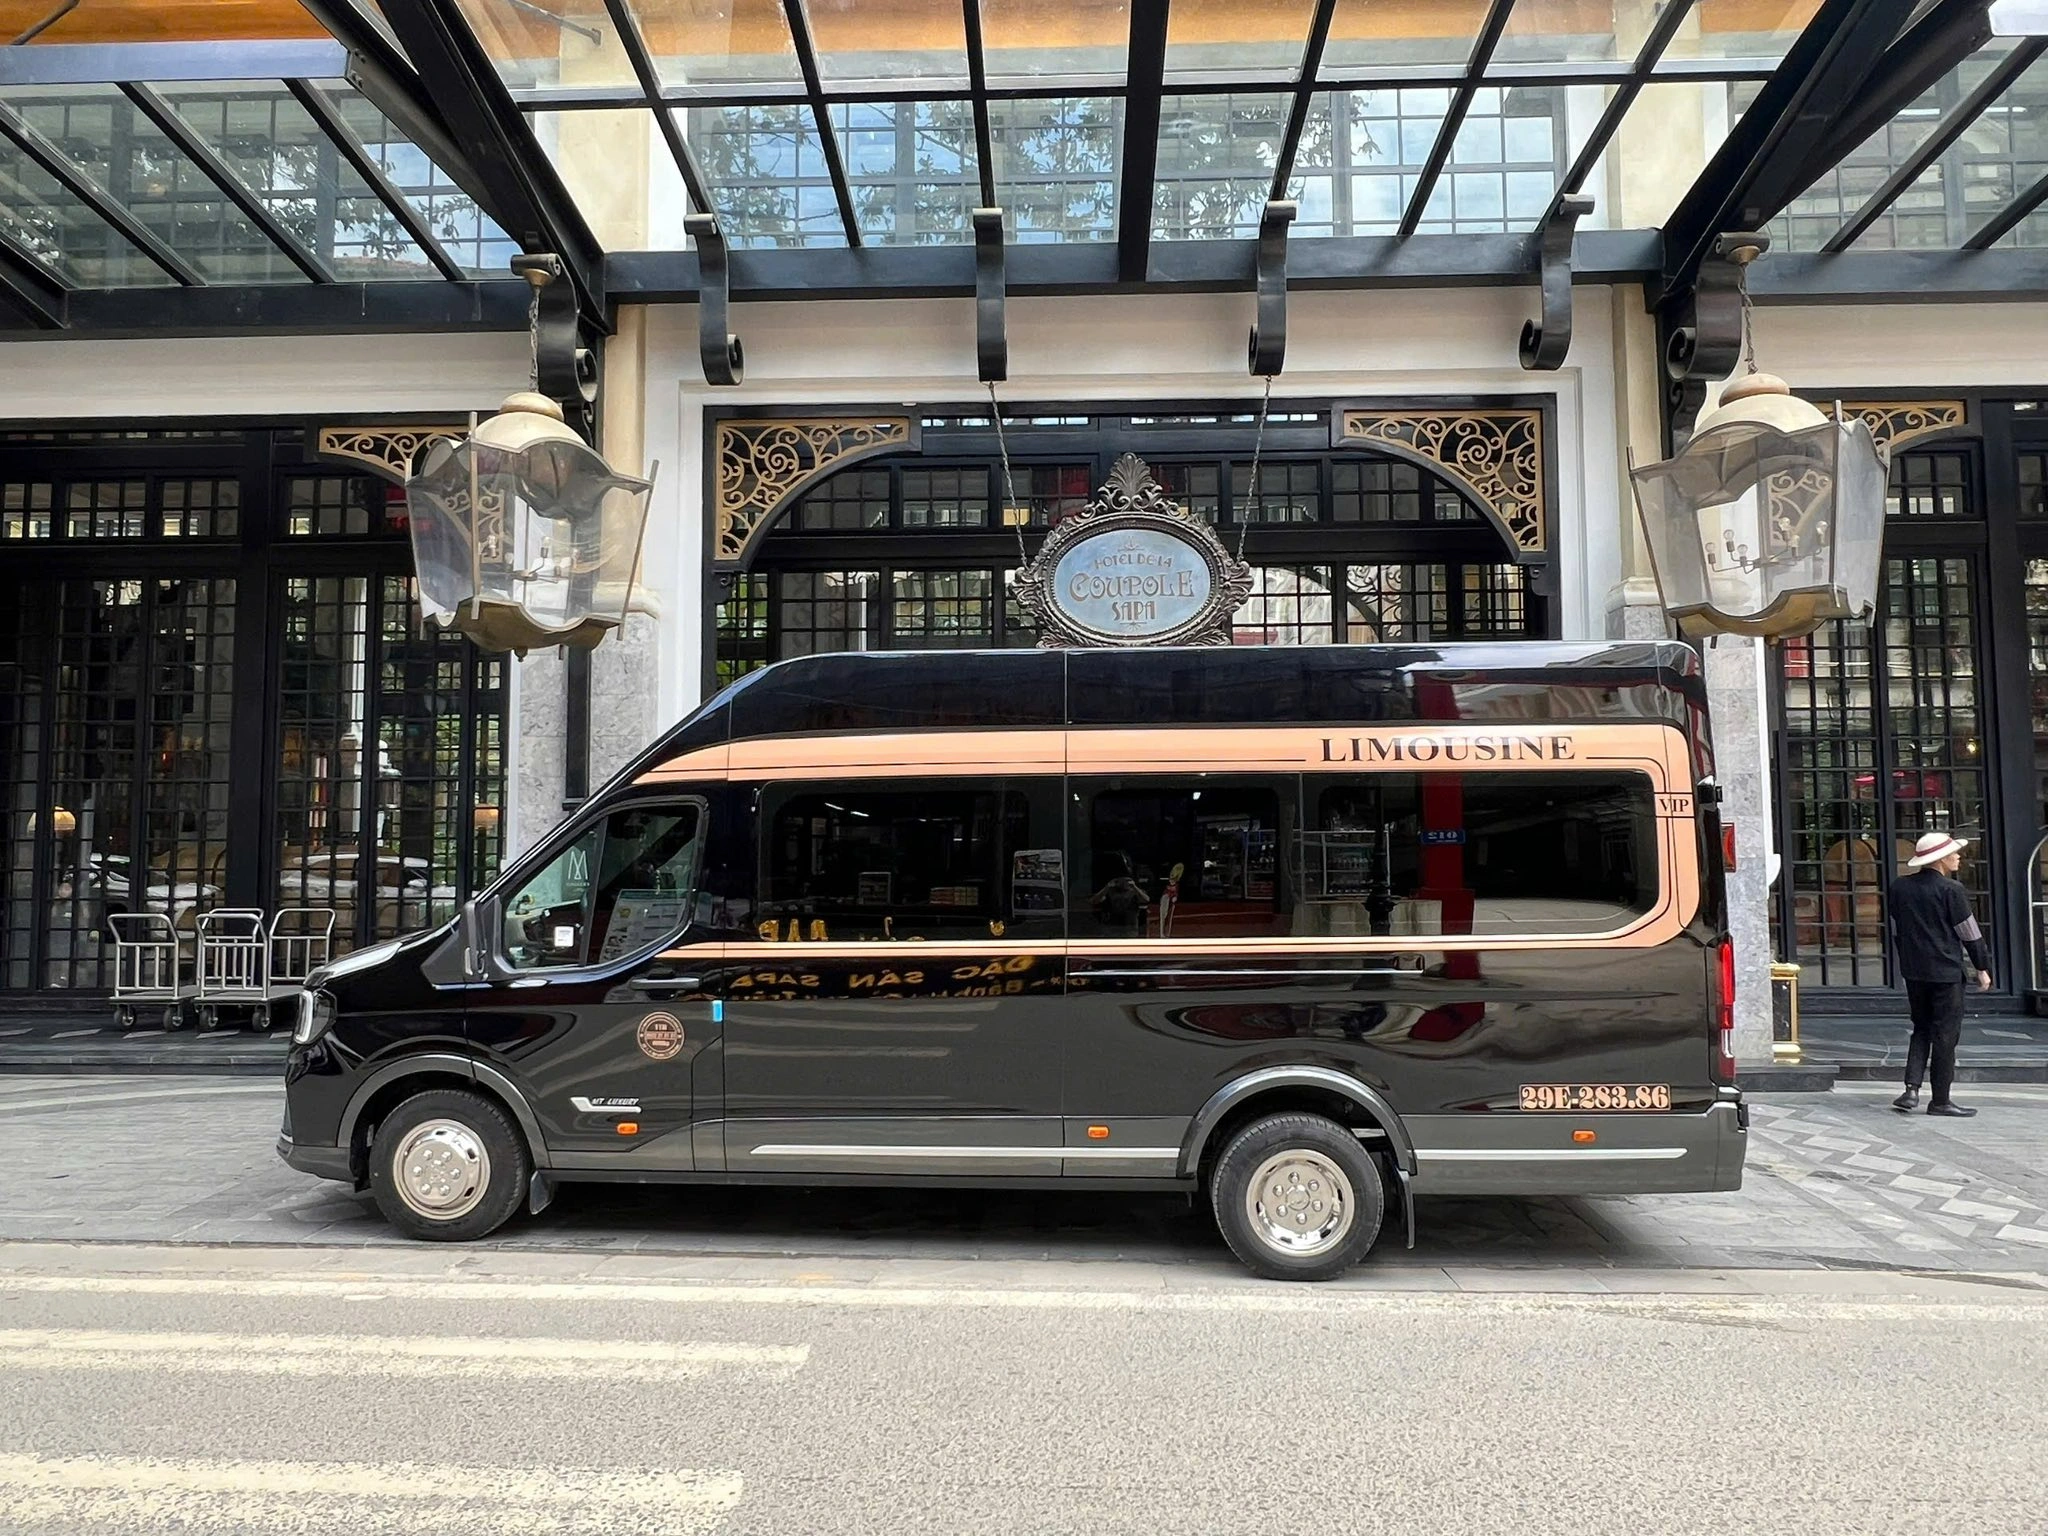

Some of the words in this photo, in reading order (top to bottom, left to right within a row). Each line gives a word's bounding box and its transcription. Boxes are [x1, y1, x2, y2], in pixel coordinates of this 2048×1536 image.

[1094, 554, 1133, 569] HOTEL
[1069, 570, 1195, 602] COUPOLE
[1112, 600, 1156, 621] SAPA
[1320, 736, 1576, 762] LIMOUSINE
[1659, 798, 1689, 812] VIP
[1521, 1085, 1669, 1110] 29E-283.86
